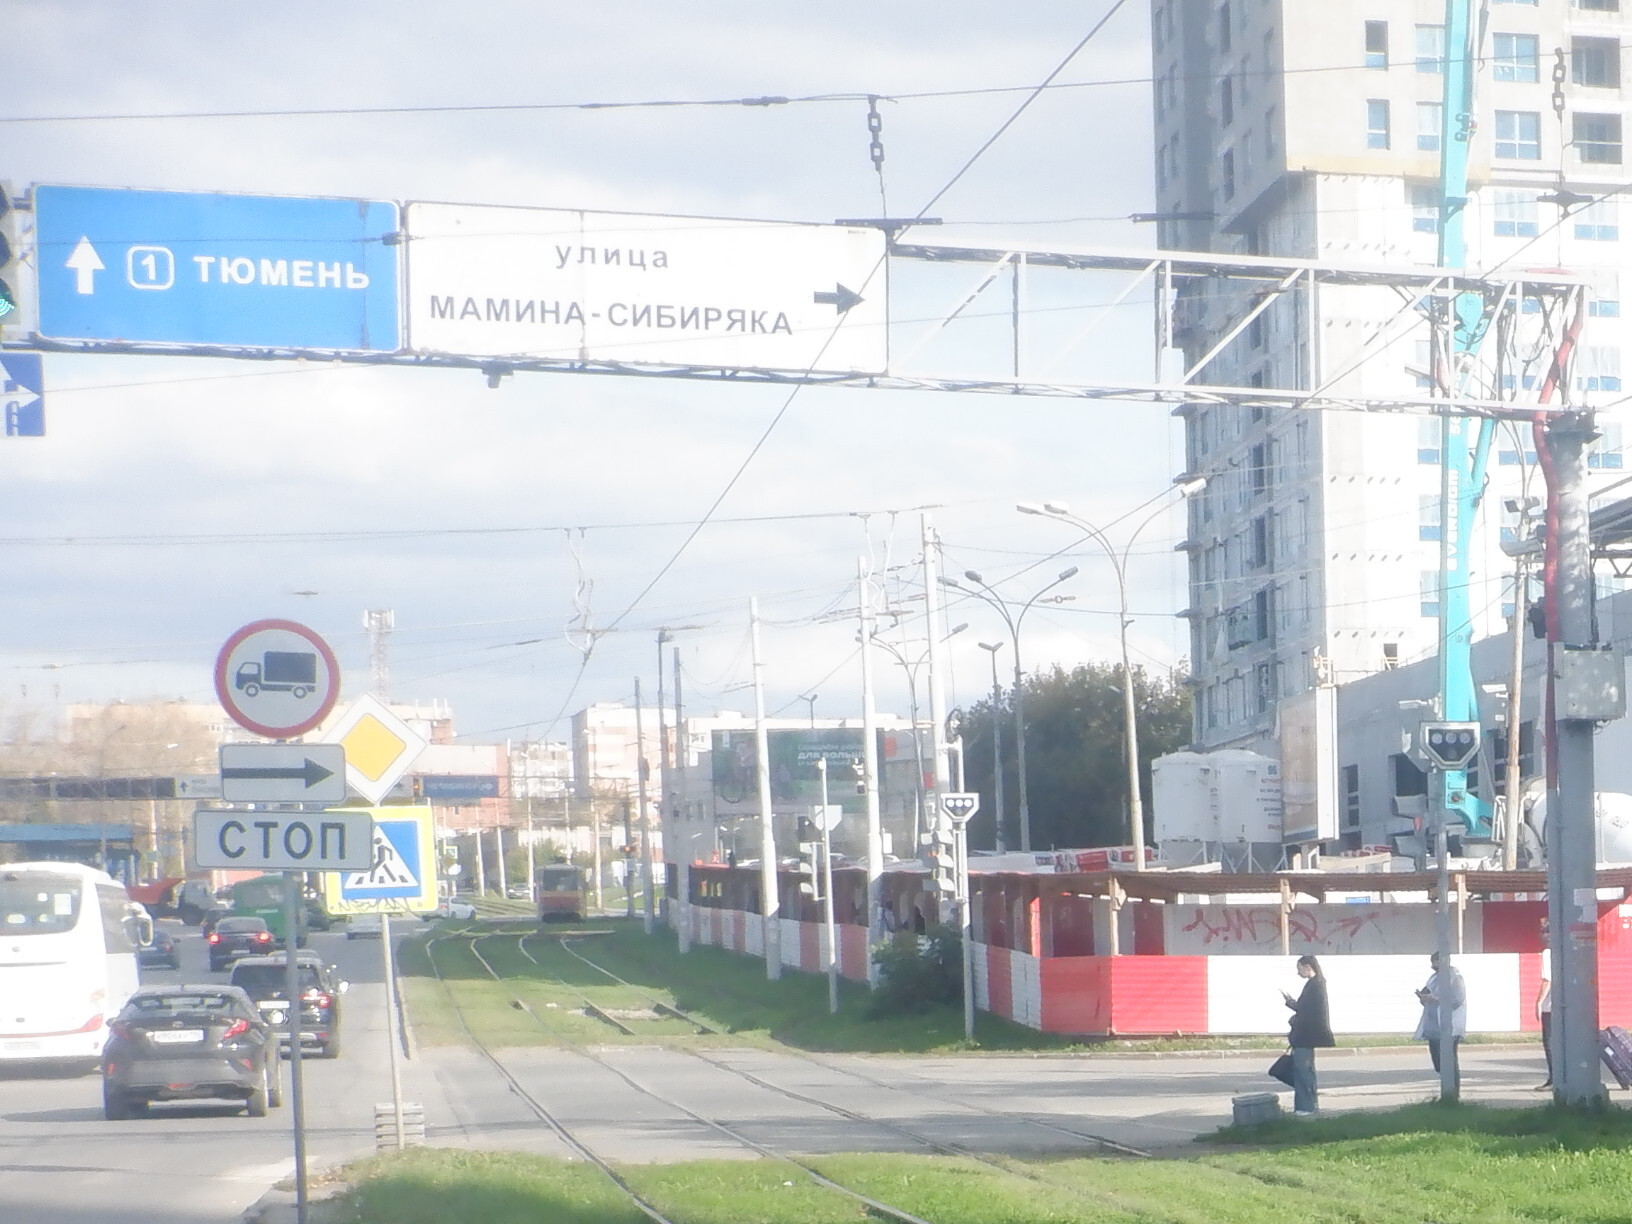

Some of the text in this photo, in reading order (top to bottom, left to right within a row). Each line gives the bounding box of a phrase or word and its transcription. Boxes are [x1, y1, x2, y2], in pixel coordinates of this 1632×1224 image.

[141, 253, 370, 290] 1 ТЮМЕНЬ
[554, 245, 669, 271] улица
[430, 294, 794, 336] МАМИНА-СИБИРЯКА
[218, 820, 347, 861] СТОП
